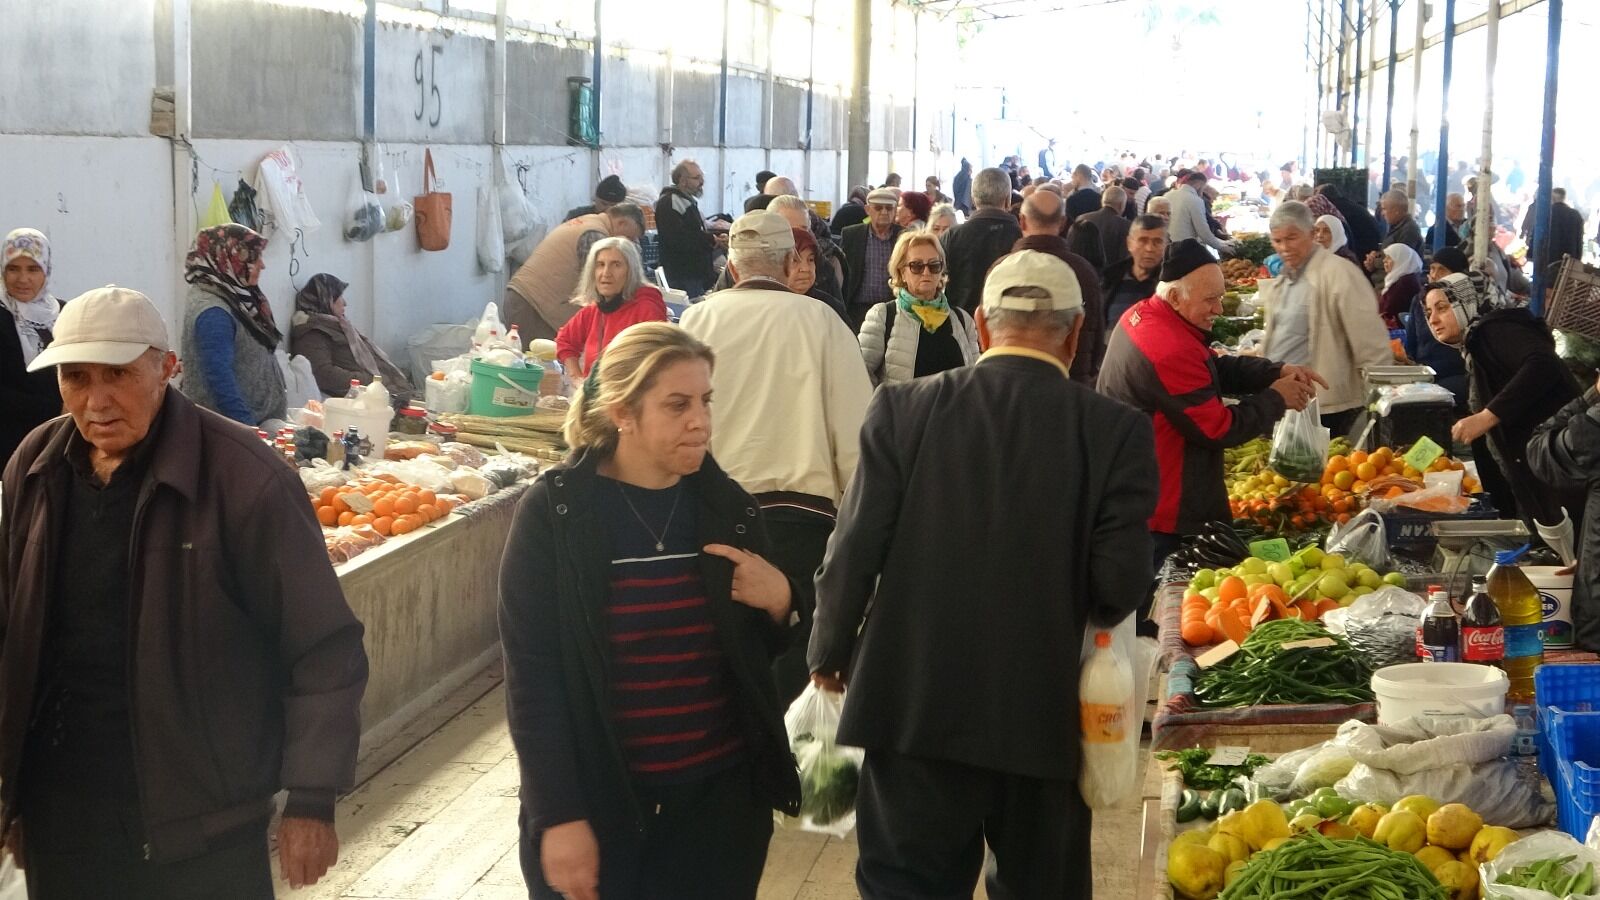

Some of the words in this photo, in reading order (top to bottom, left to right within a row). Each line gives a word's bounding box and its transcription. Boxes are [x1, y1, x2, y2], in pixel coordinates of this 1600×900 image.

[414, 45, 443, 128] 95
[1400, 525, 1433, 537] KAN
[1542, 602, 1554, 611] ER
